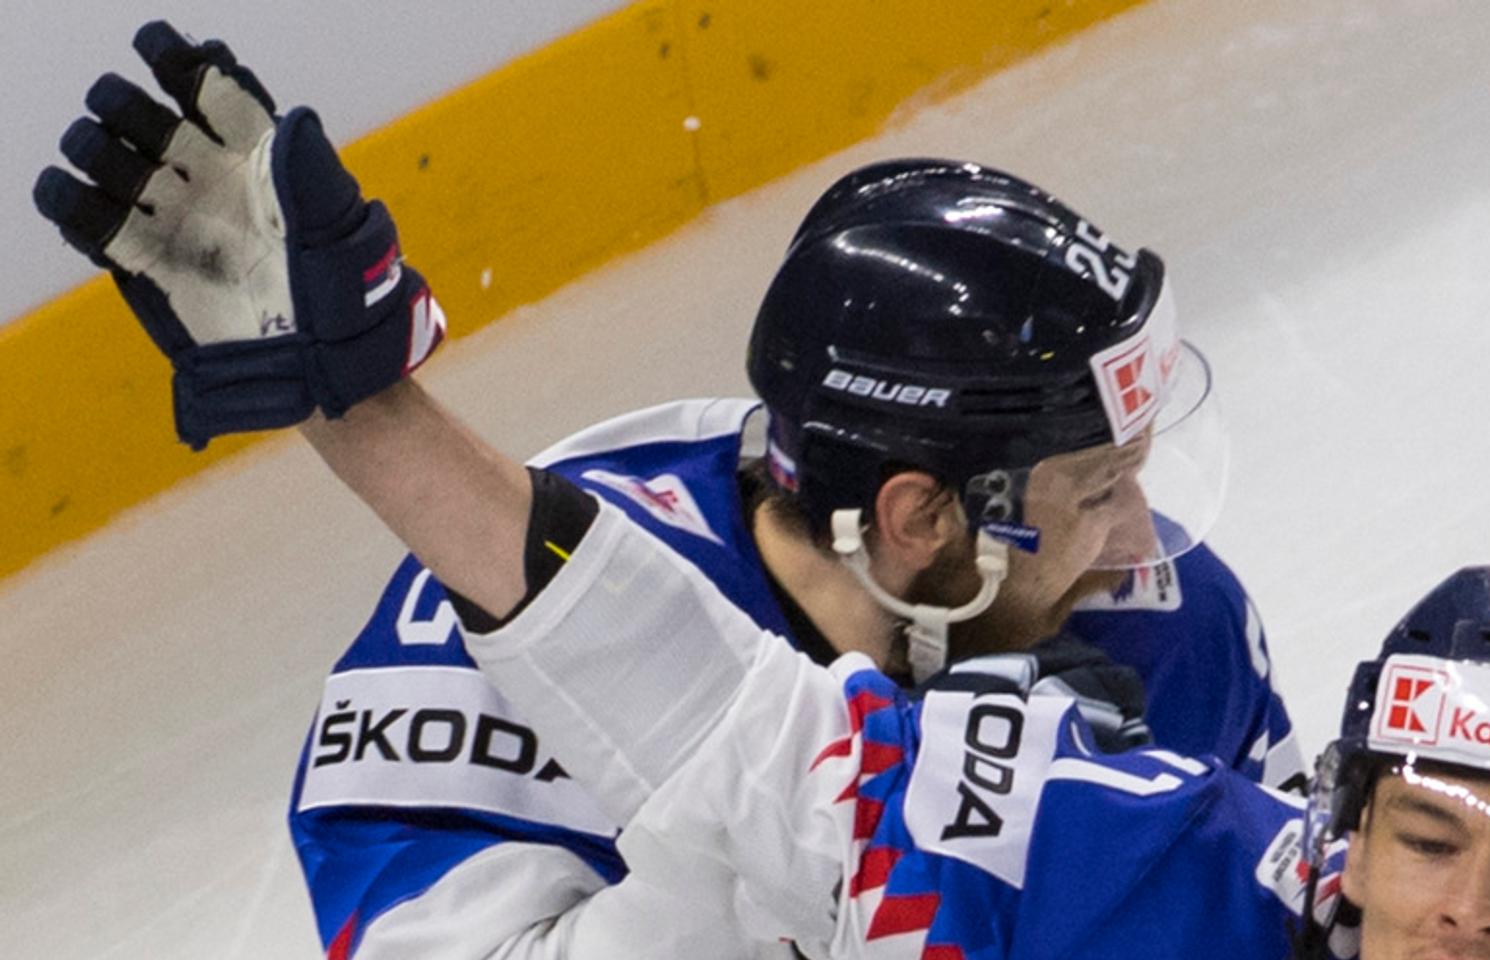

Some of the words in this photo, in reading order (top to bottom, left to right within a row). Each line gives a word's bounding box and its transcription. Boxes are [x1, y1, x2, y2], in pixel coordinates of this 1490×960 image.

[1064, 219, 1138, 300] 25
[822, 369, 952, 408] BAUER
[314, 700, 571, 783] ŠKOD
[940, 704, 1024, 841] ODA
